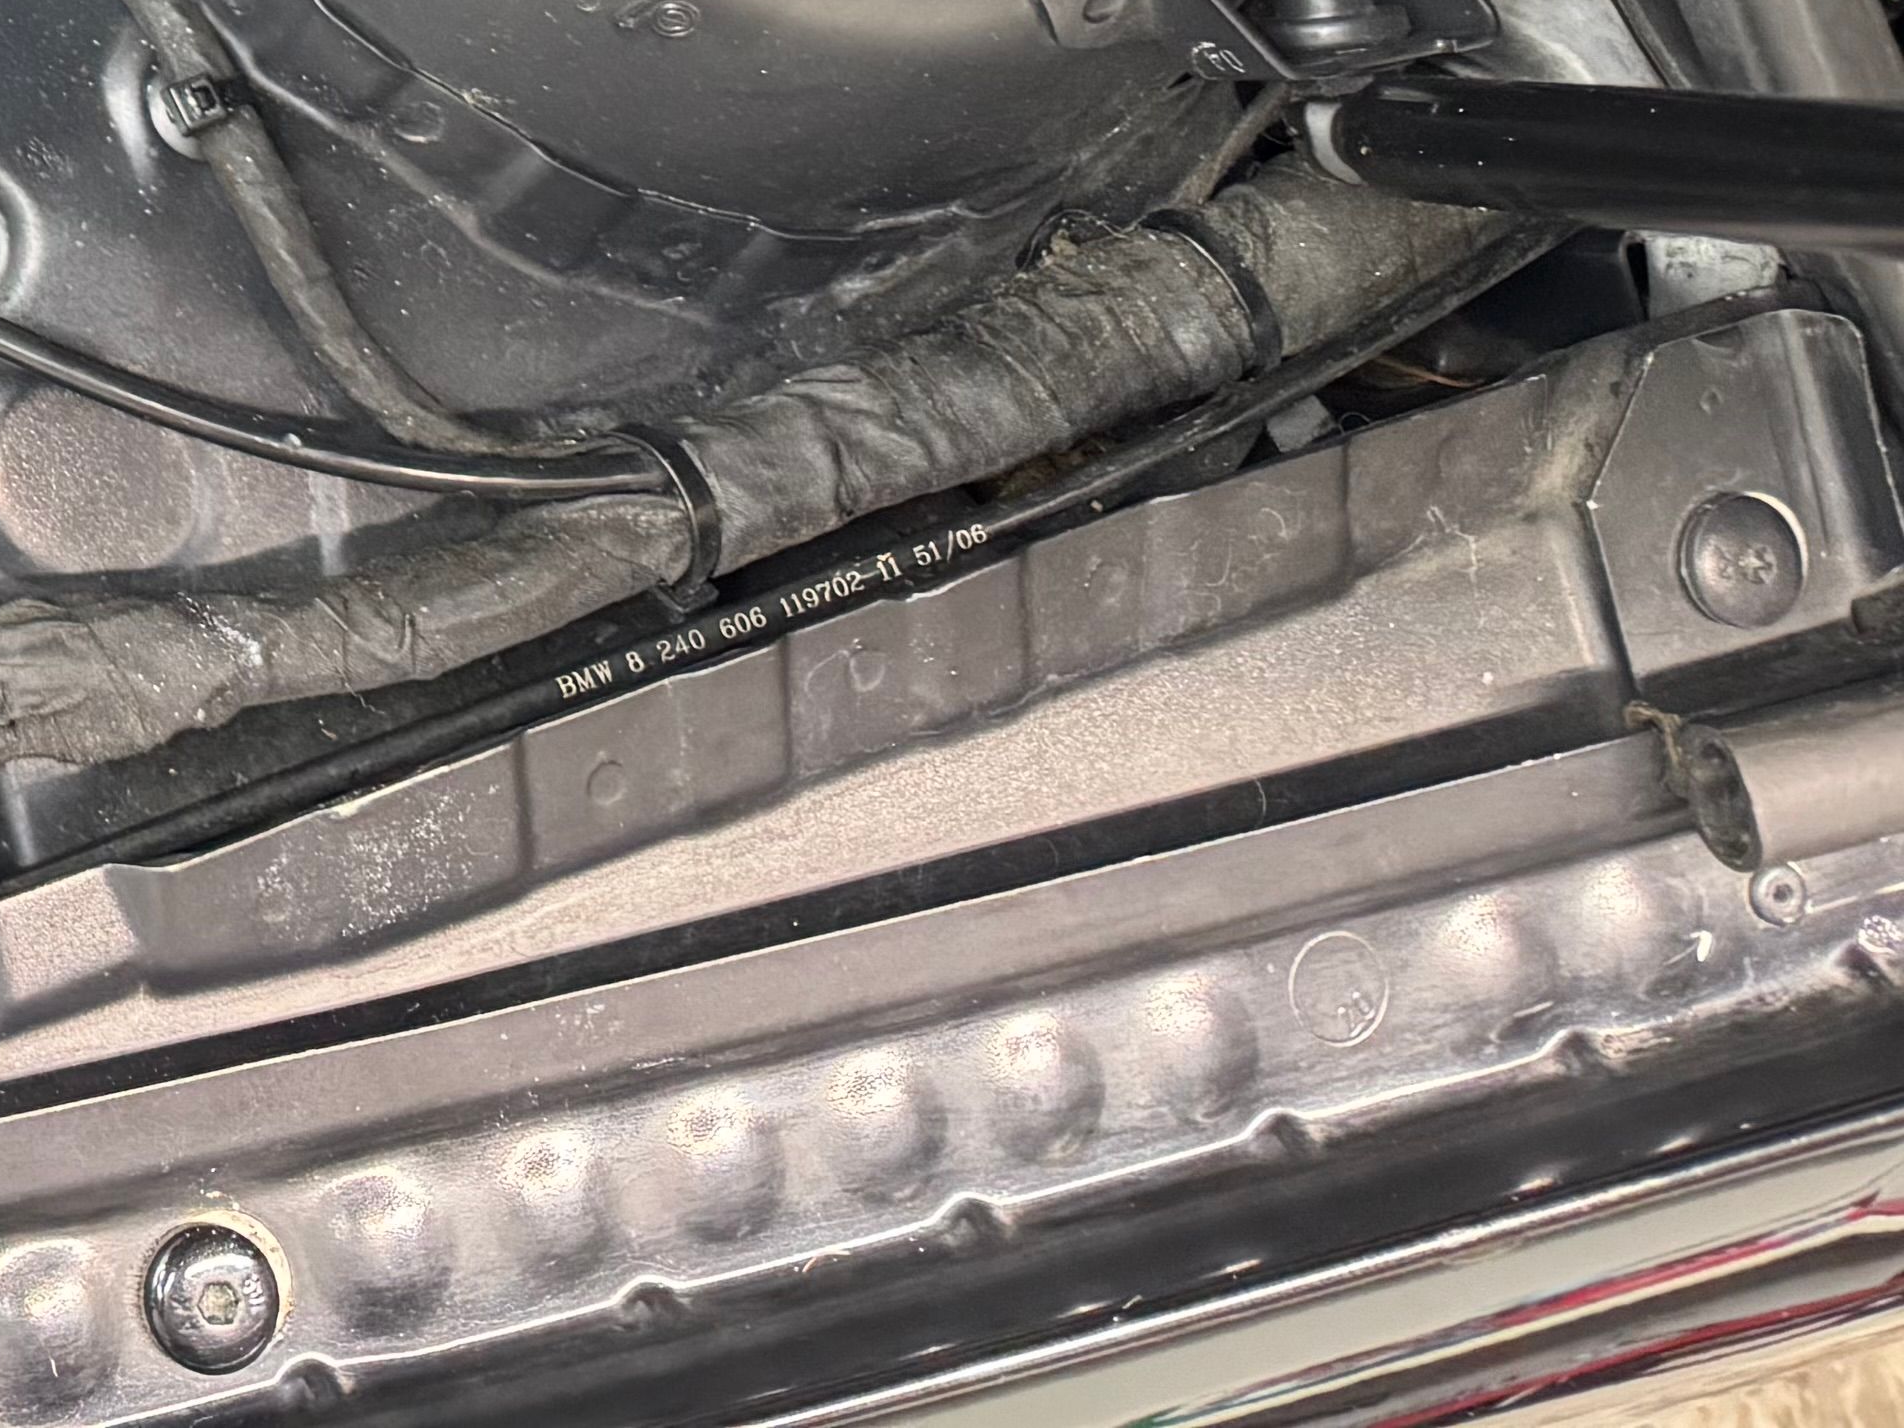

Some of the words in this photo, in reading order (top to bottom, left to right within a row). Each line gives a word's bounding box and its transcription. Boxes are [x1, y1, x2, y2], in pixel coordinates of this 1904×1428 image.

[555, 659, 614, 700] BMW
[627, 652, 645, 673] 8
[656, 629, 706, 662] 240
[719, 607, 768, 640] 606
[913, 523, 988, 567] 51/06
